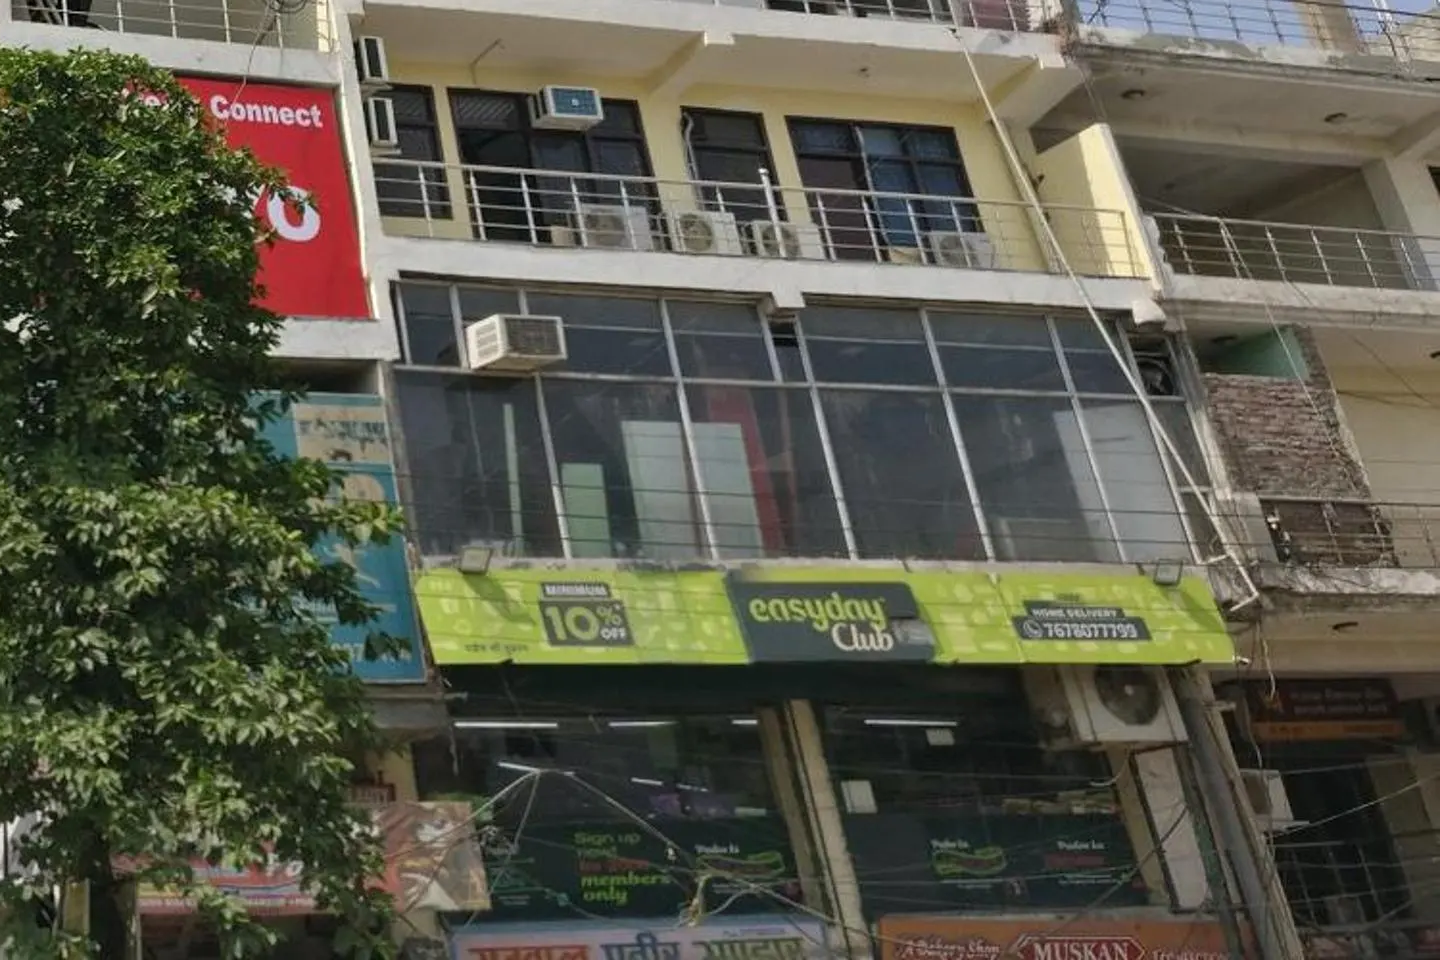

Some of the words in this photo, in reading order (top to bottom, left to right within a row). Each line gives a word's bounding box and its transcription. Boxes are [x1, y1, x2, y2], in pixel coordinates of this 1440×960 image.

[210, 94, 324, 128] Connect
[749, 591, 886, 632] easyday
[600, 627, 626, 640] OFF
[831, 622, 894, 652] Club
[1033, 942, 1130, 960] MUSKAN
